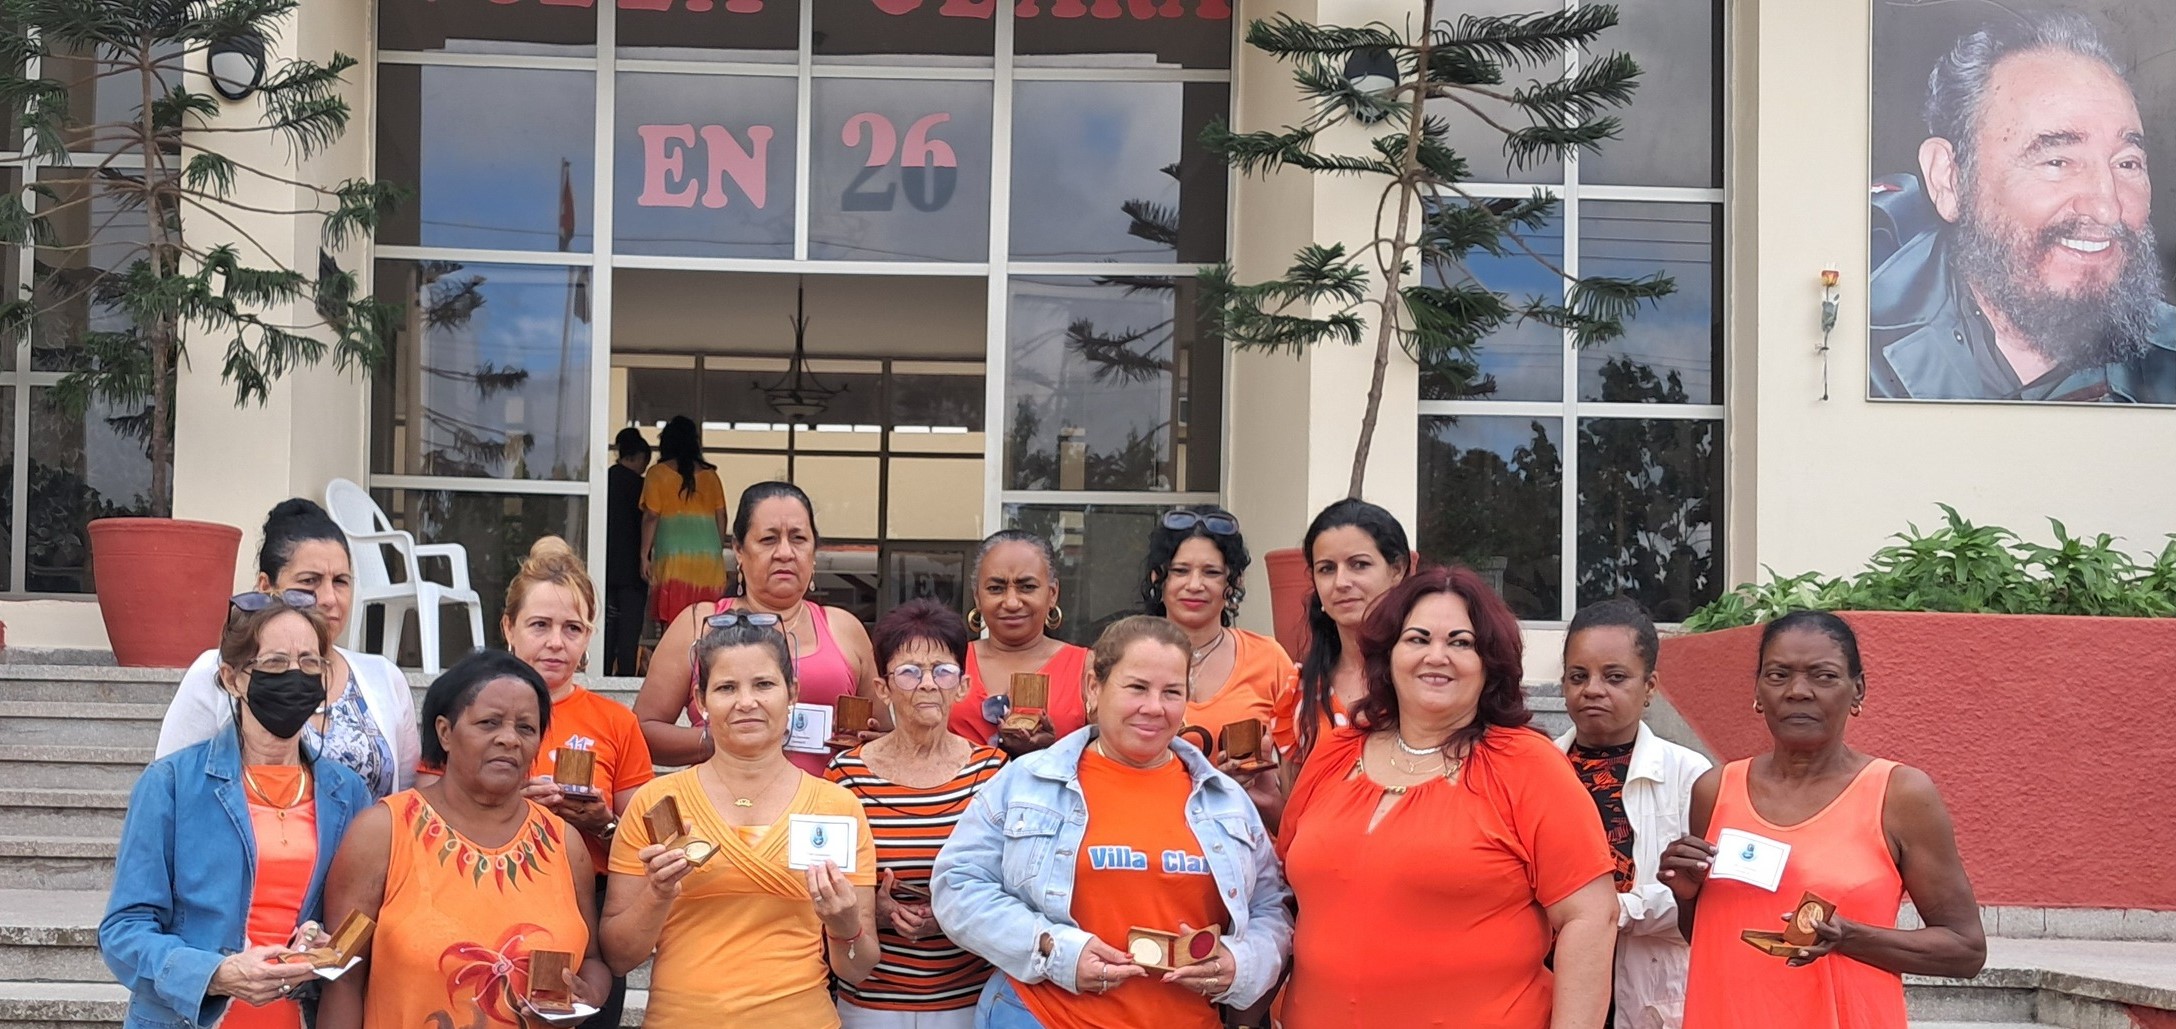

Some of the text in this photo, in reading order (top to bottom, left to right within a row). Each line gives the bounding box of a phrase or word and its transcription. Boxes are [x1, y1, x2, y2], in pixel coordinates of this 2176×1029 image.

[638, 111, 958, 213] EN 26
[1089, 847, 1210, 874] Villa Clar
